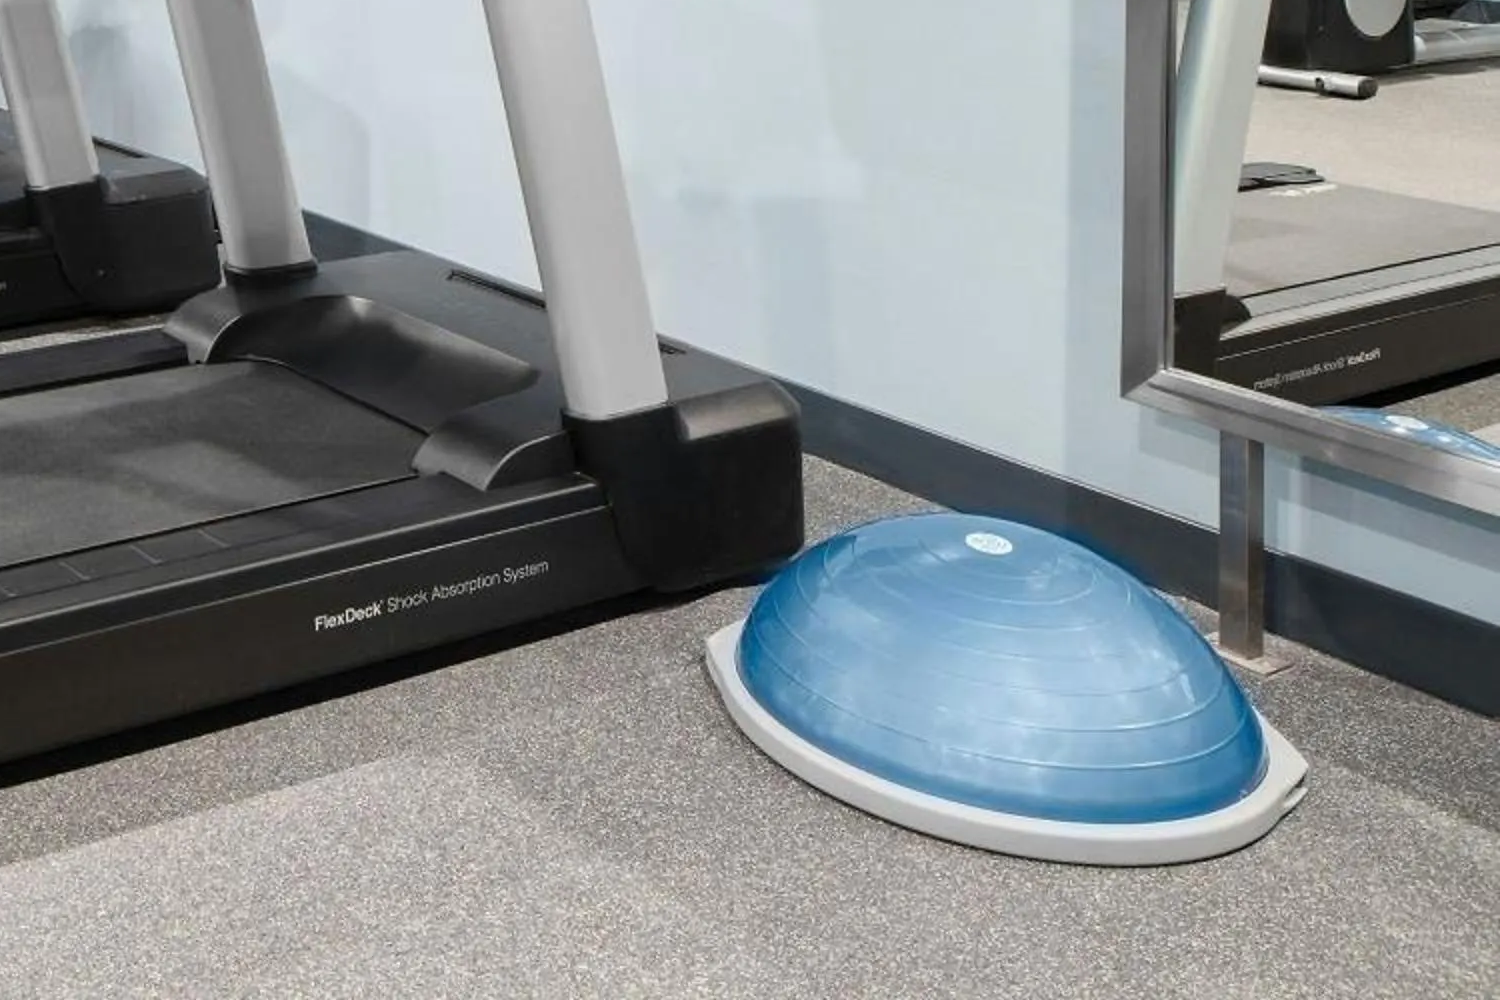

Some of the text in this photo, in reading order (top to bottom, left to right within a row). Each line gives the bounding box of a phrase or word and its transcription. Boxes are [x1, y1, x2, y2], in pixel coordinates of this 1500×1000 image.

[387, 589, 428, 613] Shock
[431, 573, 500, 601] Absorption
[503, 560, 549, 584] System
